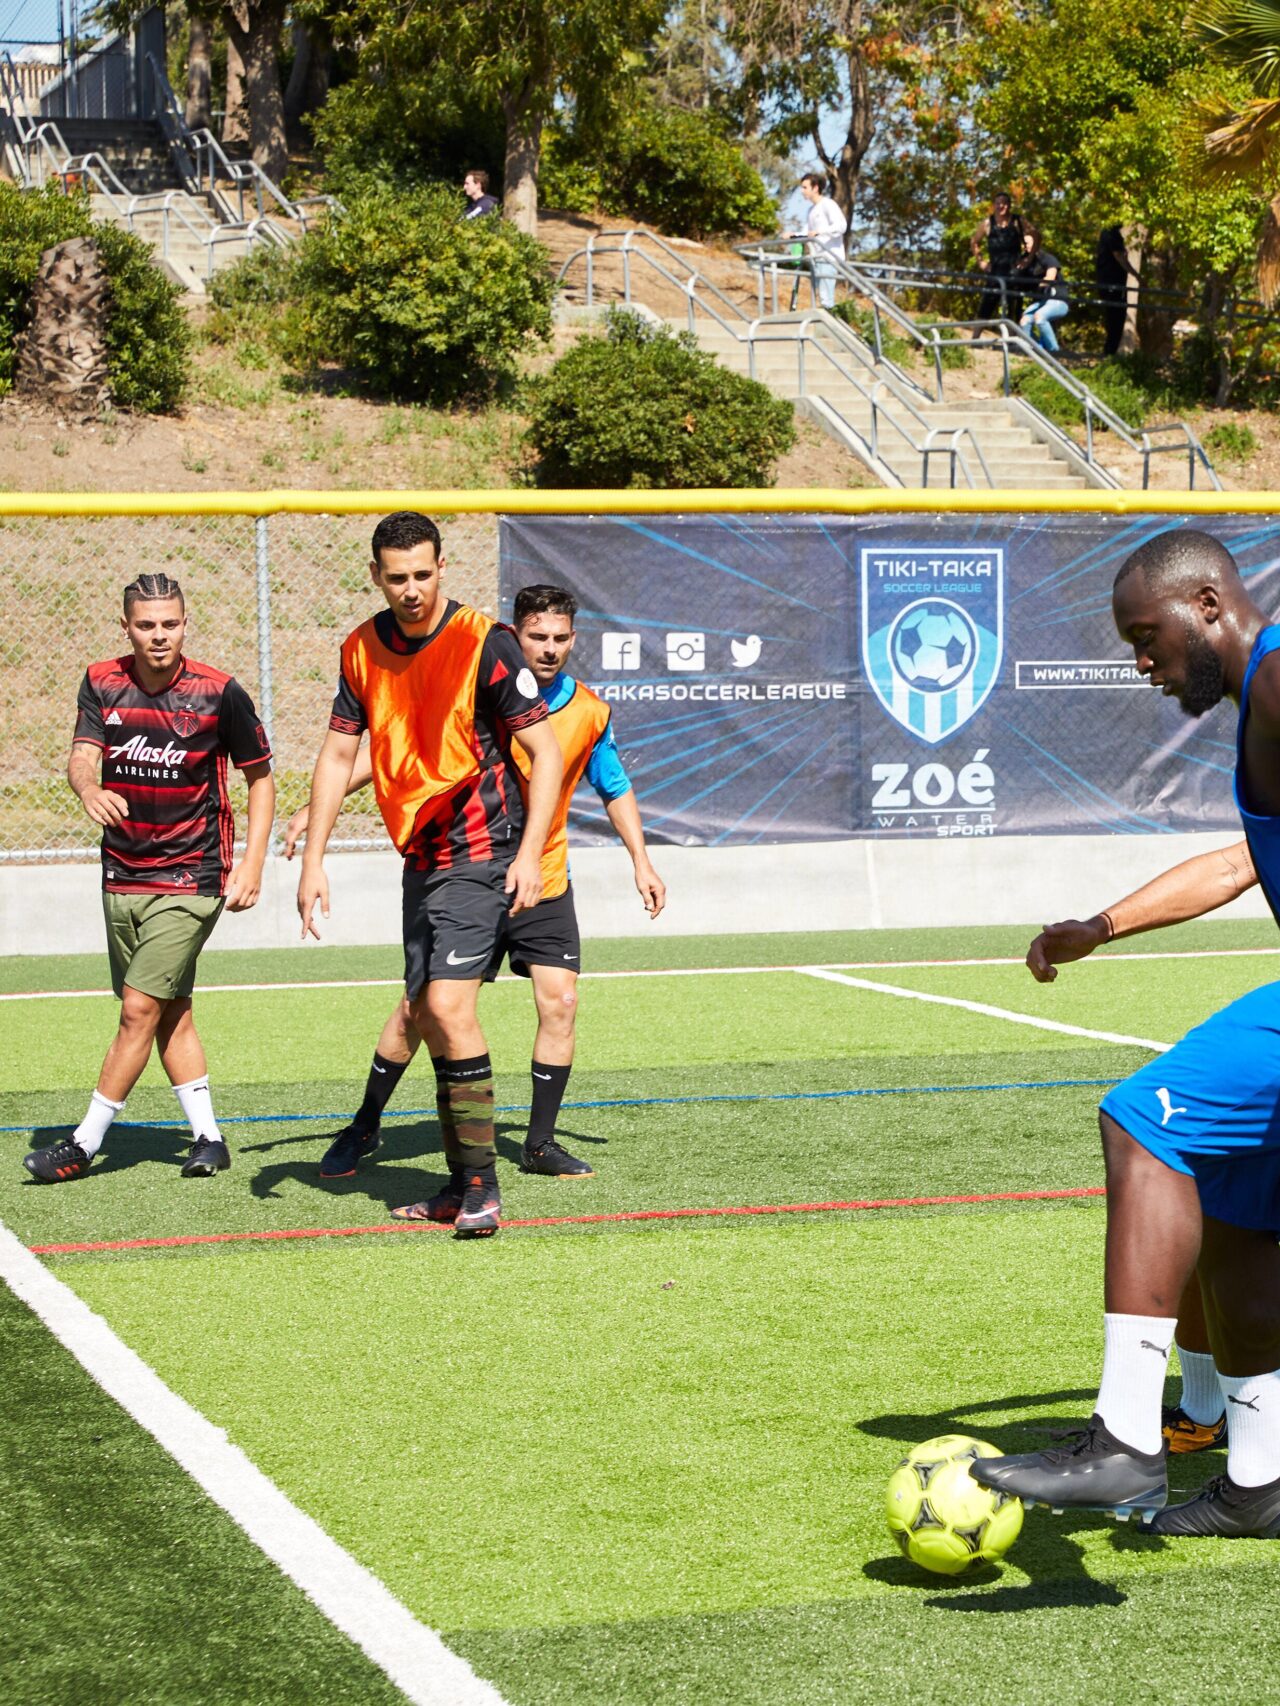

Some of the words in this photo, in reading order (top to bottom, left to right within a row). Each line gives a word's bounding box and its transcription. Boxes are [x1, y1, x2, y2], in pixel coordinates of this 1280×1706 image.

[873, 560, 992, 577] TIKI-TAKA
[883, 583, 931, 593] SOCCER
[934, 583, 982, 593] LEAGUE
[108, 735, 188, 768] Alaska
[115, 765, 179, 780] AIRLINES
[877, 814, 993, 828] WATER
[937, 824, 998, 837] SPORT
